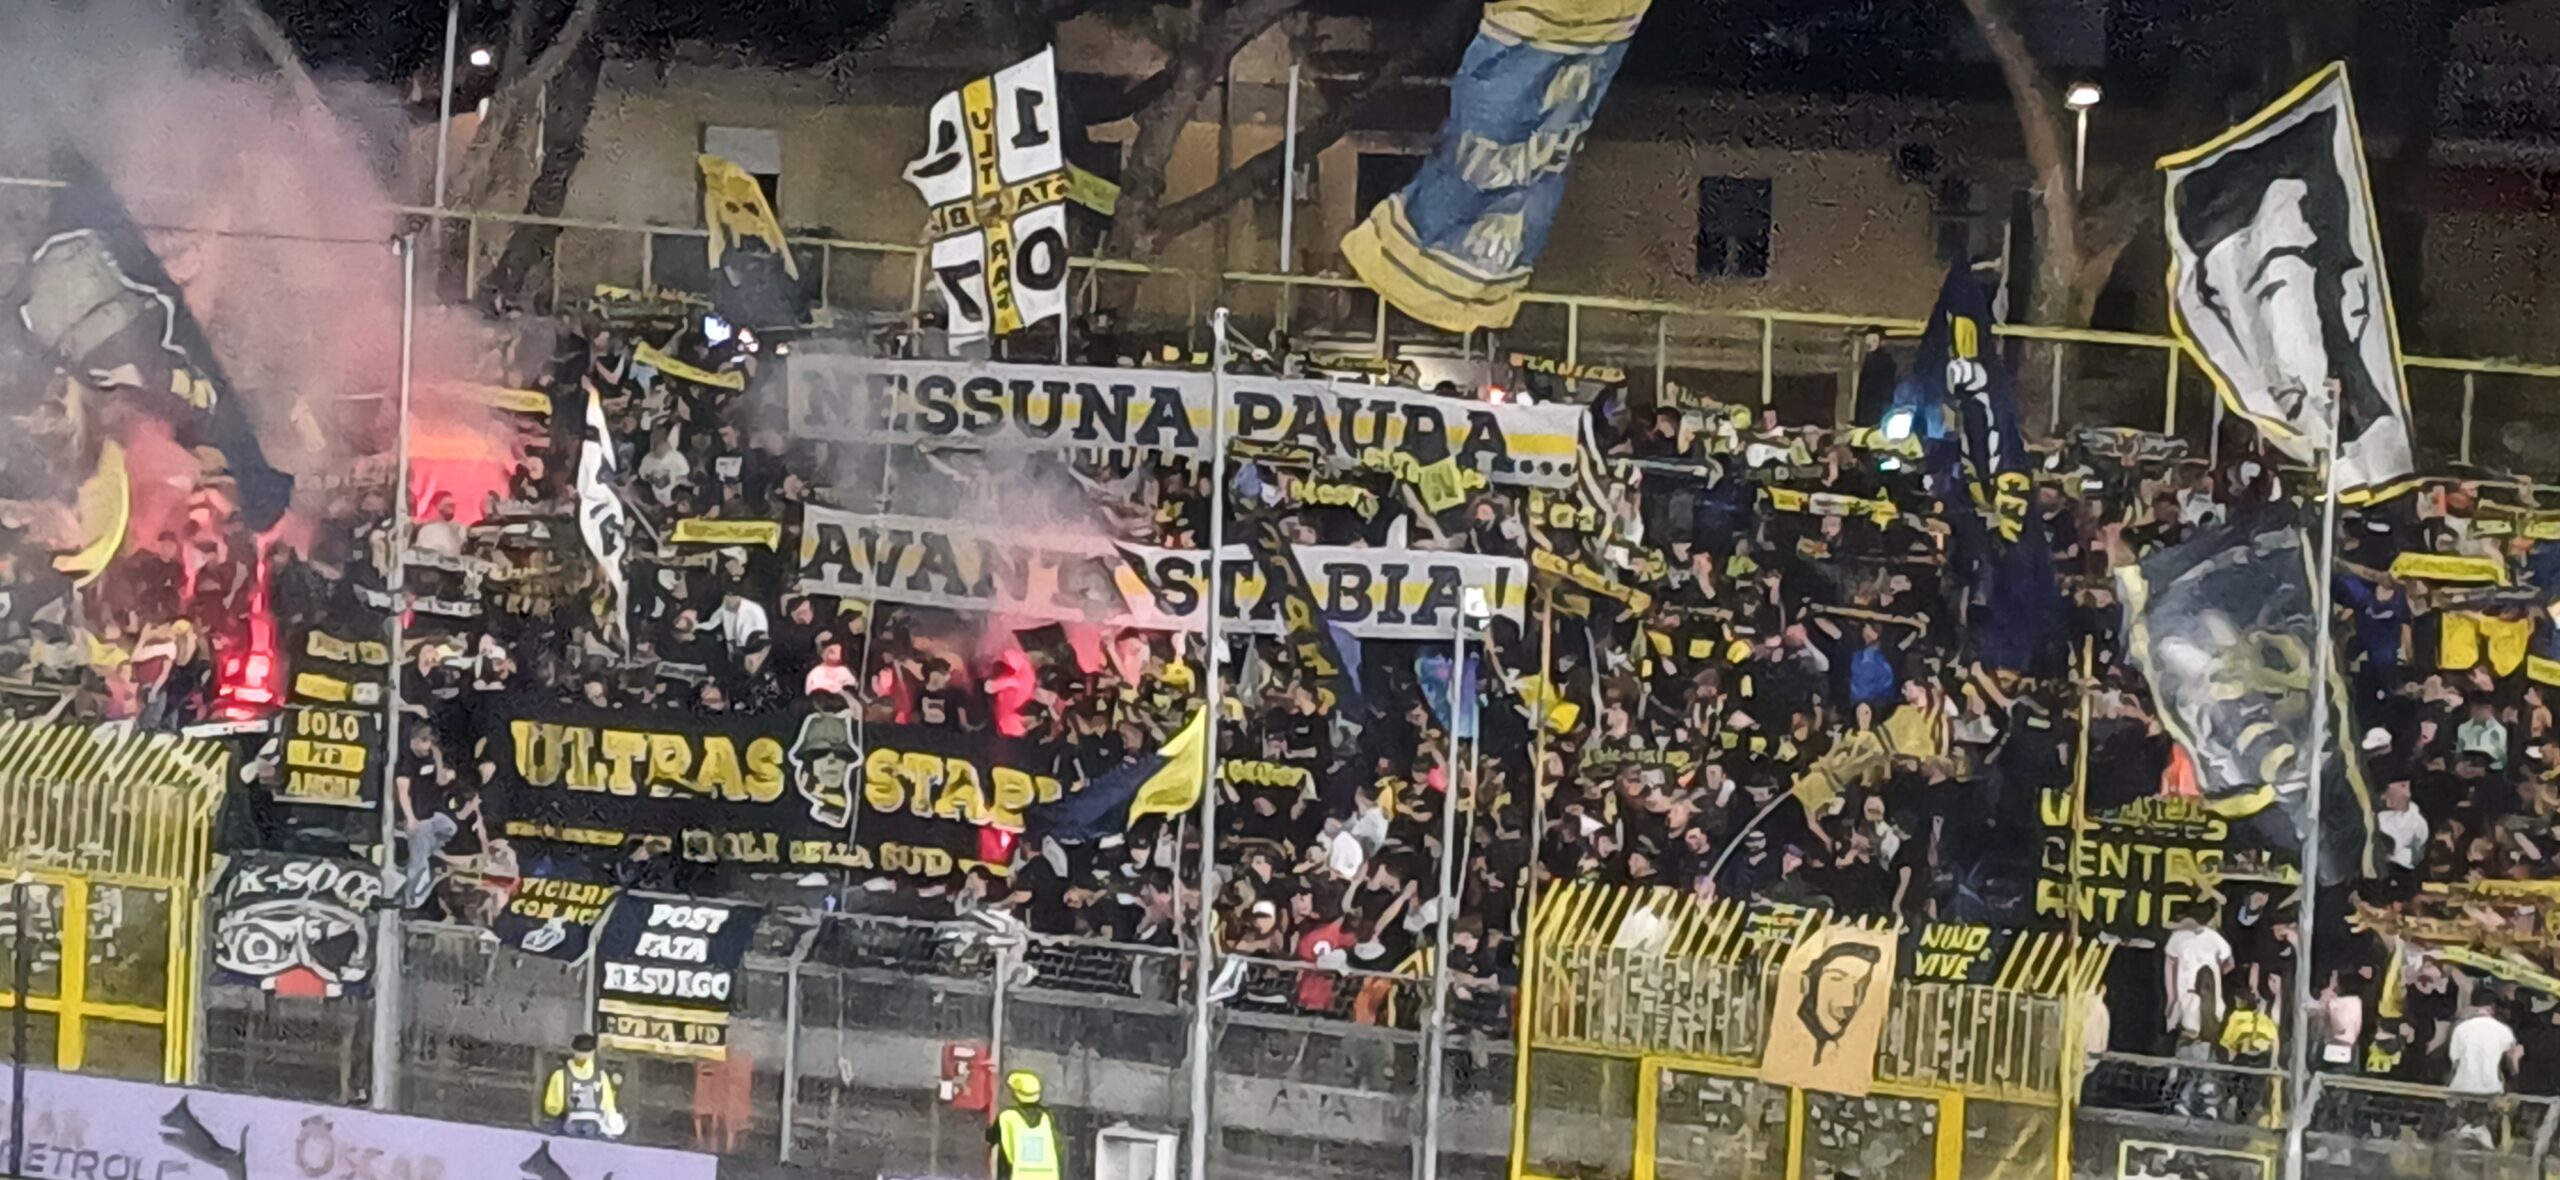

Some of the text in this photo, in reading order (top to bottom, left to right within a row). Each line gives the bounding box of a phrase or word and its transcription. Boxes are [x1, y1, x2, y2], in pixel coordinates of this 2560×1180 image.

[510, 719, 1062, 834] ULTRAS STAB
[648, 904, 729, 933] POST
[2036, 879, 2222, 930] ANTIC
[635, 932, 708, 963] FATA
[1919, 922, 1991, 952] NINO
[1915, 950, 1975, 979] VIVE
